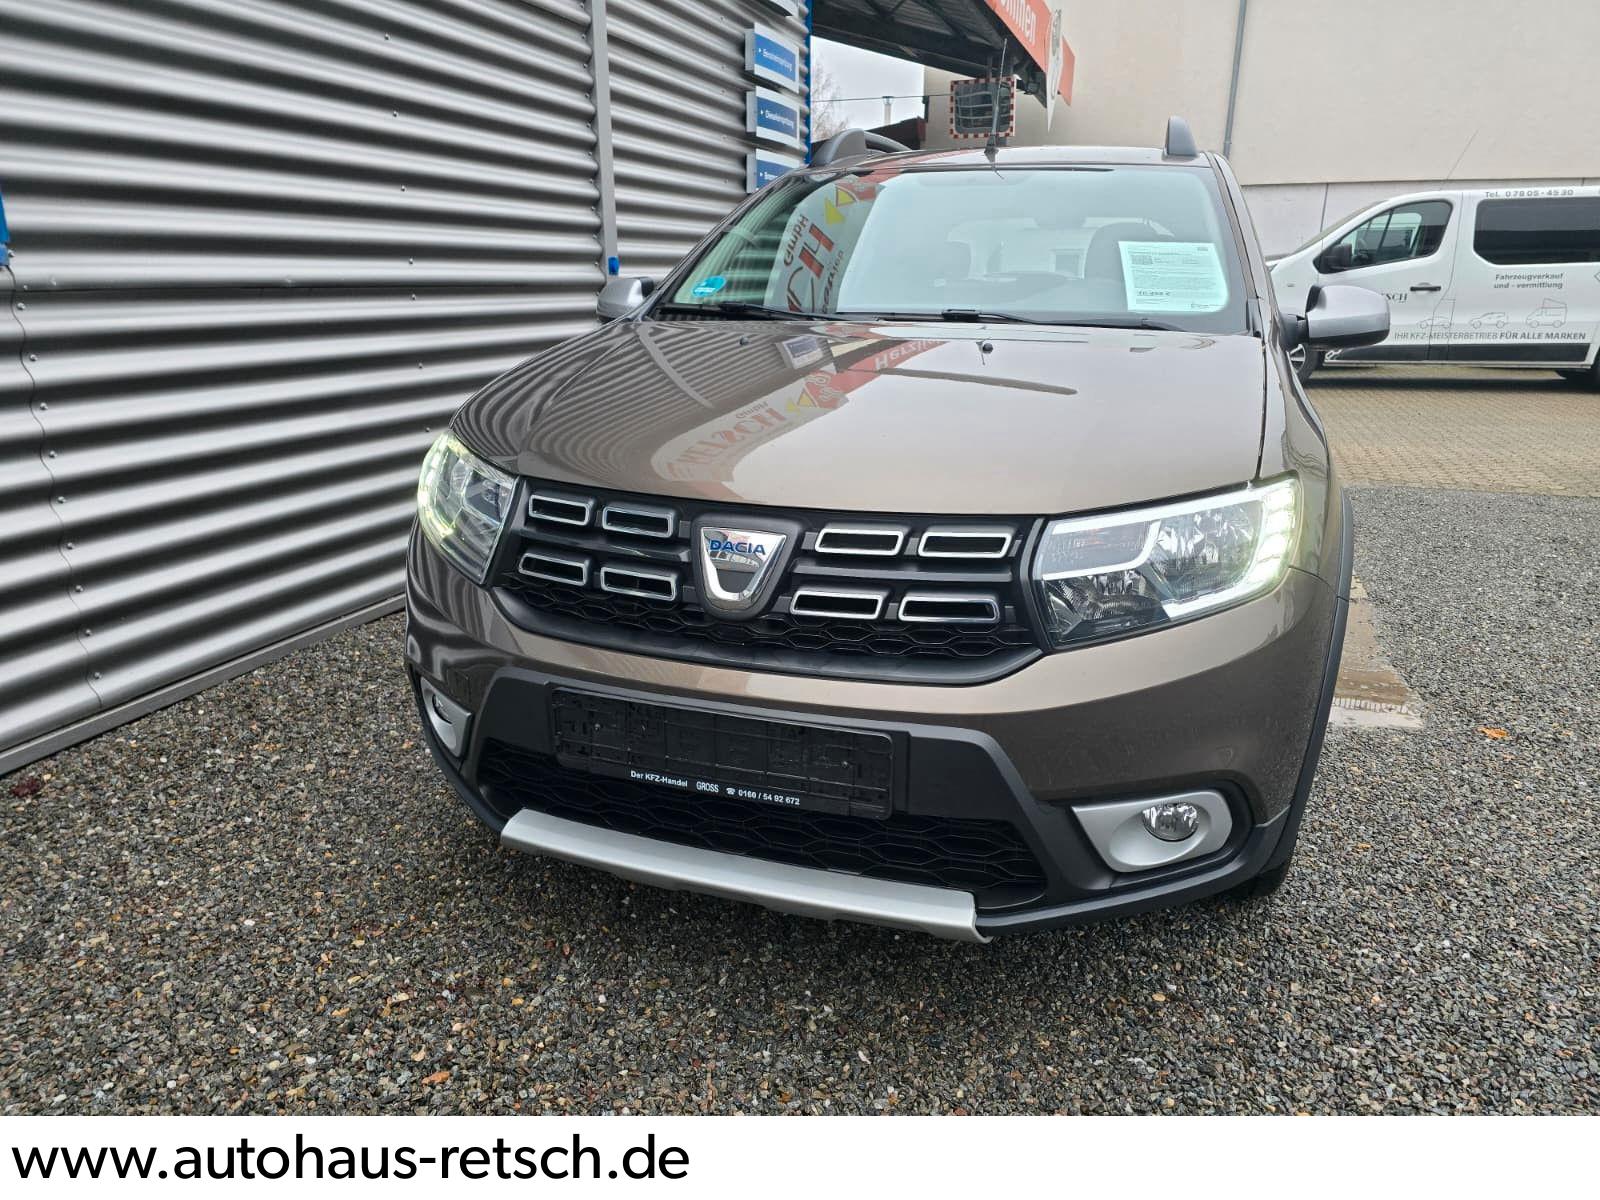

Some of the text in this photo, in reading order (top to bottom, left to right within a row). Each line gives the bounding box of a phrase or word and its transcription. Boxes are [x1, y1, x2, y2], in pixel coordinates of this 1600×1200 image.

[1495, 272, 1563, 281] Fahrzeugverkauf
[1516, 281, 1563, 289] vermittlung
[1394, 331, 1586, 340] IHR KFZ-MEISTERBETRIEB FÜR ALLE MARKEN
[709, 539, 766, 556] DACIA
[630, 770, 645, 780] Der
[645, 773, 688, 788] KFZ-Handel
[696, 781, 720, 794] GROSS
[763, 793, 773, 801] 54
[774, 795, 784, 803] 92
[785, 796, 801, 806] 672
